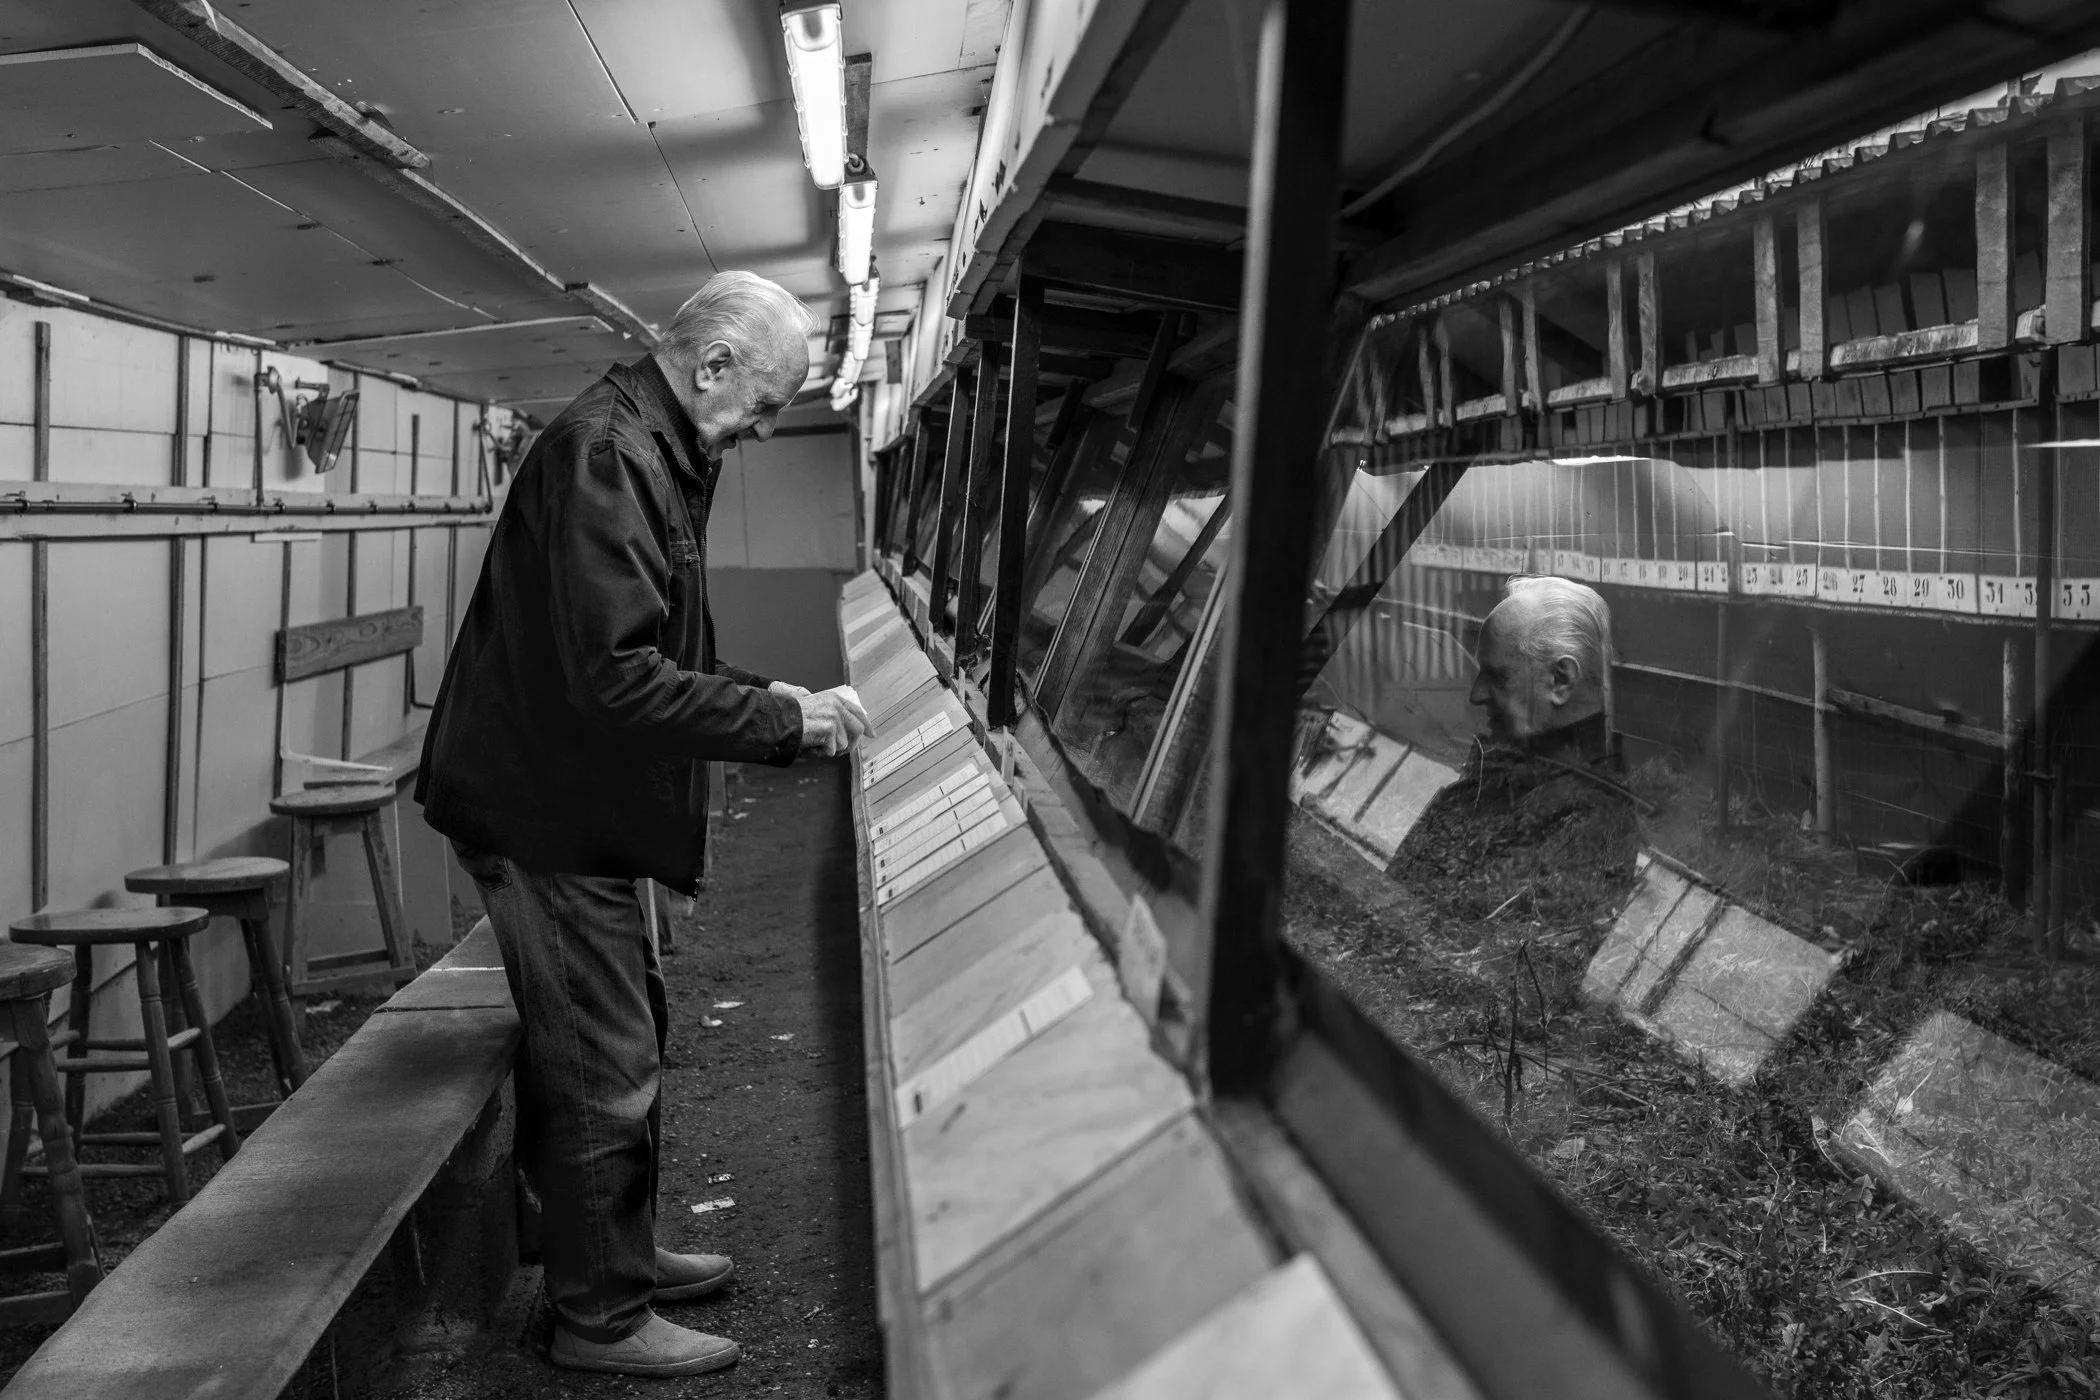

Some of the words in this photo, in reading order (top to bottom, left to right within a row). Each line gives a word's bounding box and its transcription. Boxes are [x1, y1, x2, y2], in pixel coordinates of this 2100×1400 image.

[1678, 566, 1688, 582] 20
[1704, 567, 1714, 584] 21
[1745, 568, 1758, 585] 23
[1796, 568, 1808, 587] 25
[1823, 571, 1838, 591] 26
[1853, 574, 1866, 593] 27
[1883, 576, 1897, 597] 28
[1914, 577, 1930, 597] 29
[1947, 579, 1964, 600] 30
[1986, 582, 2004, 604] 31
[2025, 583, 2035, 606] 3
[2062, 584, 2091, 607] 33
